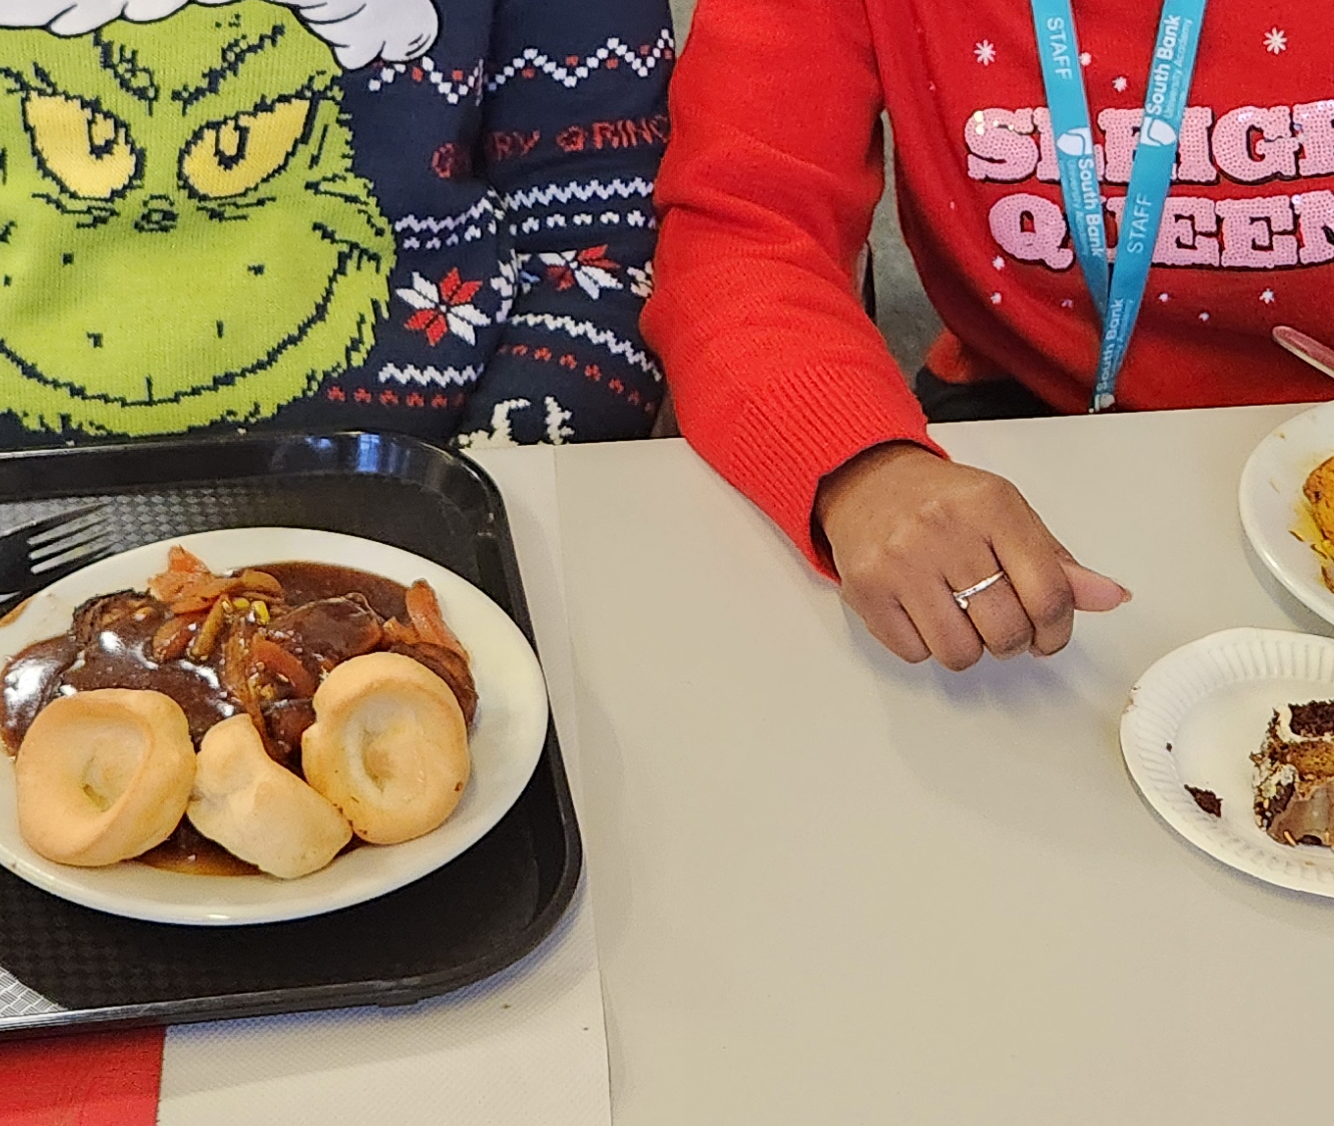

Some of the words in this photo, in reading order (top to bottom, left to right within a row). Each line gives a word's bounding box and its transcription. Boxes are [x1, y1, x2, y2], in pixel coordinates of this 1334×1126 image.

[1046, 16, 1073, 80] STAFF
[1155, 14, 1181, 61] Bank
[1145, 62, 1171, 117] South
[1078, 158, 1099, 210] South
[1085, 213, 1106, 258] Bank
[1127, 192, 1153, 255] STAFF
[1105, 296, 1125, 342] Bank
[1096, 342, 1116, 392] South
